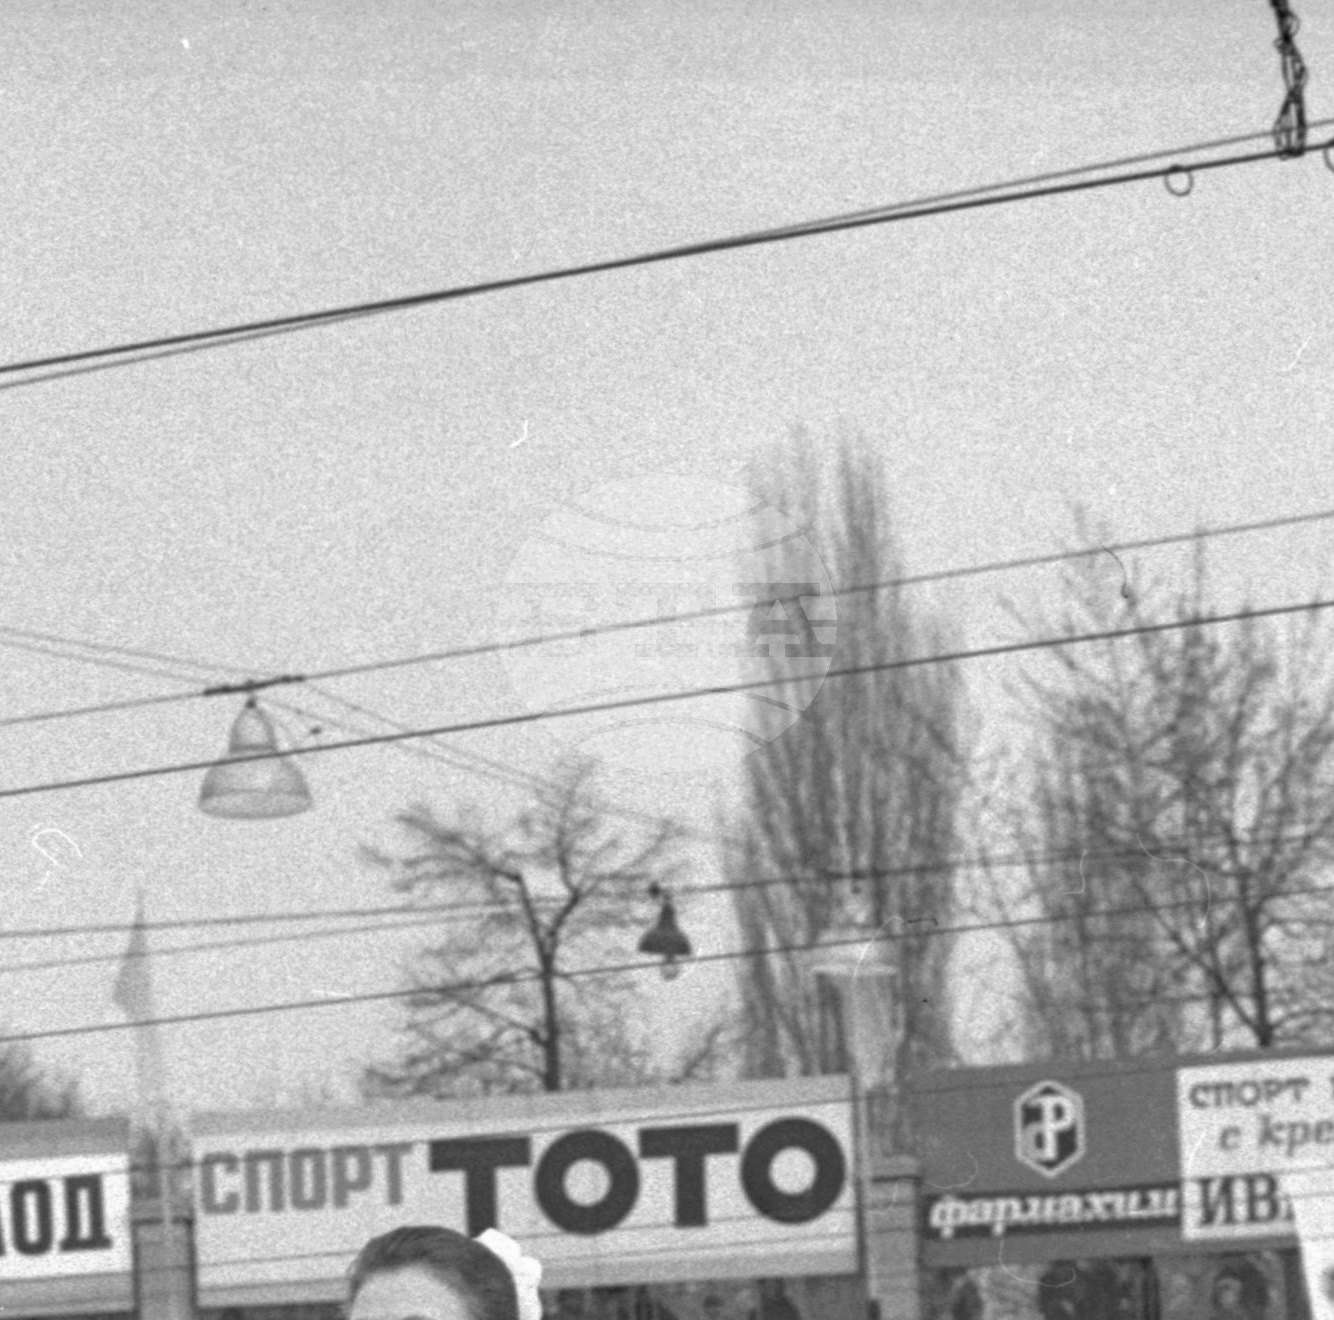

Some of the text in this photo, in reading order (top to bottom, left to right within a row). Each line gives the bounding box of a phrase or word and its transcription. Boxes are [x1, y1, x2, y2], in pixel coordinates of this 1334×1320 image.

[1189, 1077, 1310, 1109] СПОРТ
[1219, 1124, 1241, 1151] с
[201, 1115, 847, 1238] СПОРТ ТОТО
[1199, 1173, 1294, 1226] ИВ
